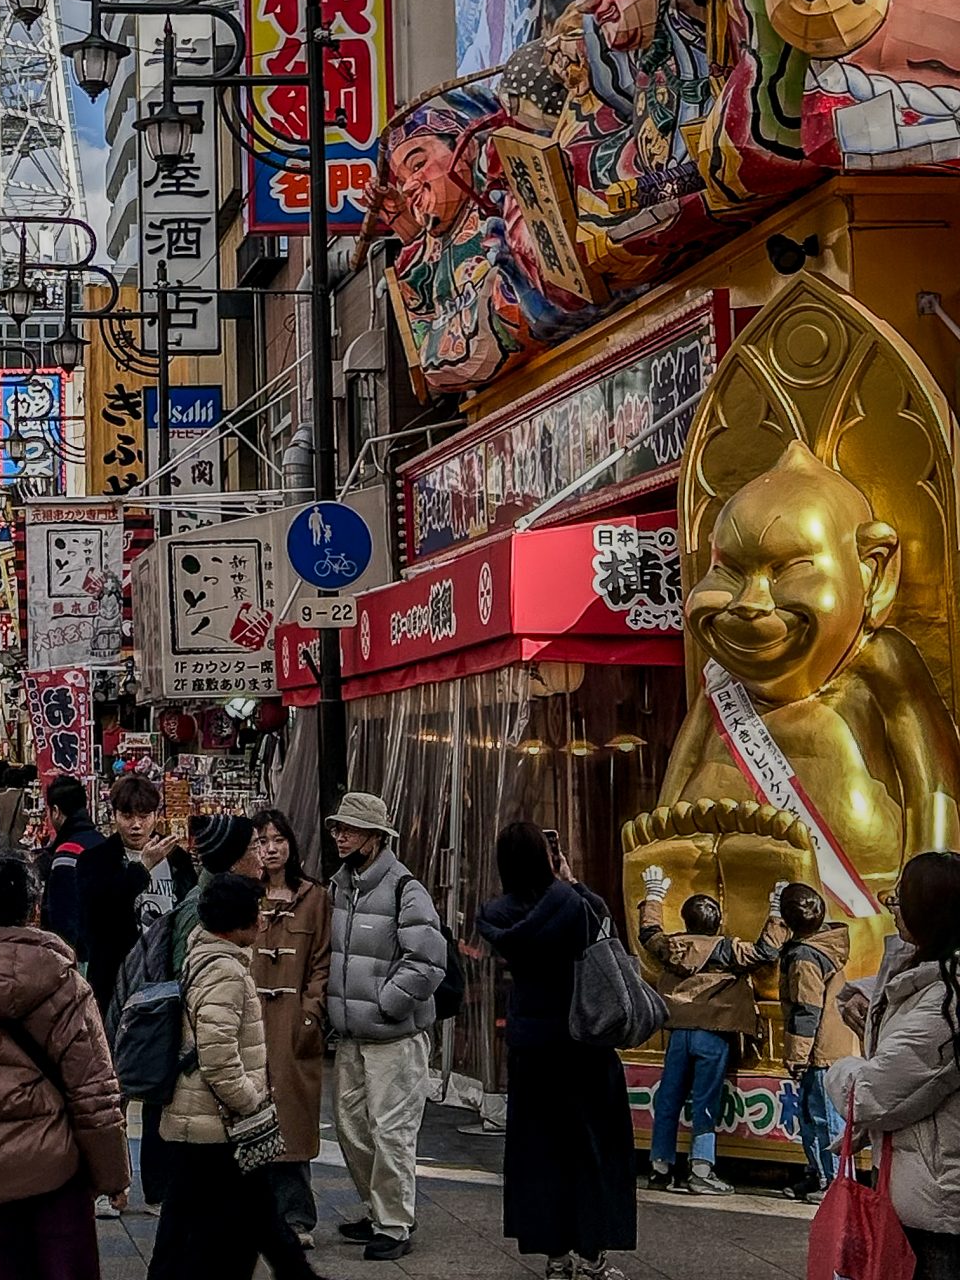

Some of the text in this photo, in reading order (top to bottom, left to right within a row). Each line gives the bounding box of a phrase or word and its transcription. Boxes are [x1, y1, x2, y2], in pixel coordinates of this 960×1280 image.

[599, 529, 676, 547] 日本一の
[228, 554, 251, 601] 新世界
[301, 604, 354, 622] 9-22
[174, 660, 274, 675] 1F カウンター席
[173, 677, 274, 692] 2F 座敷あります
